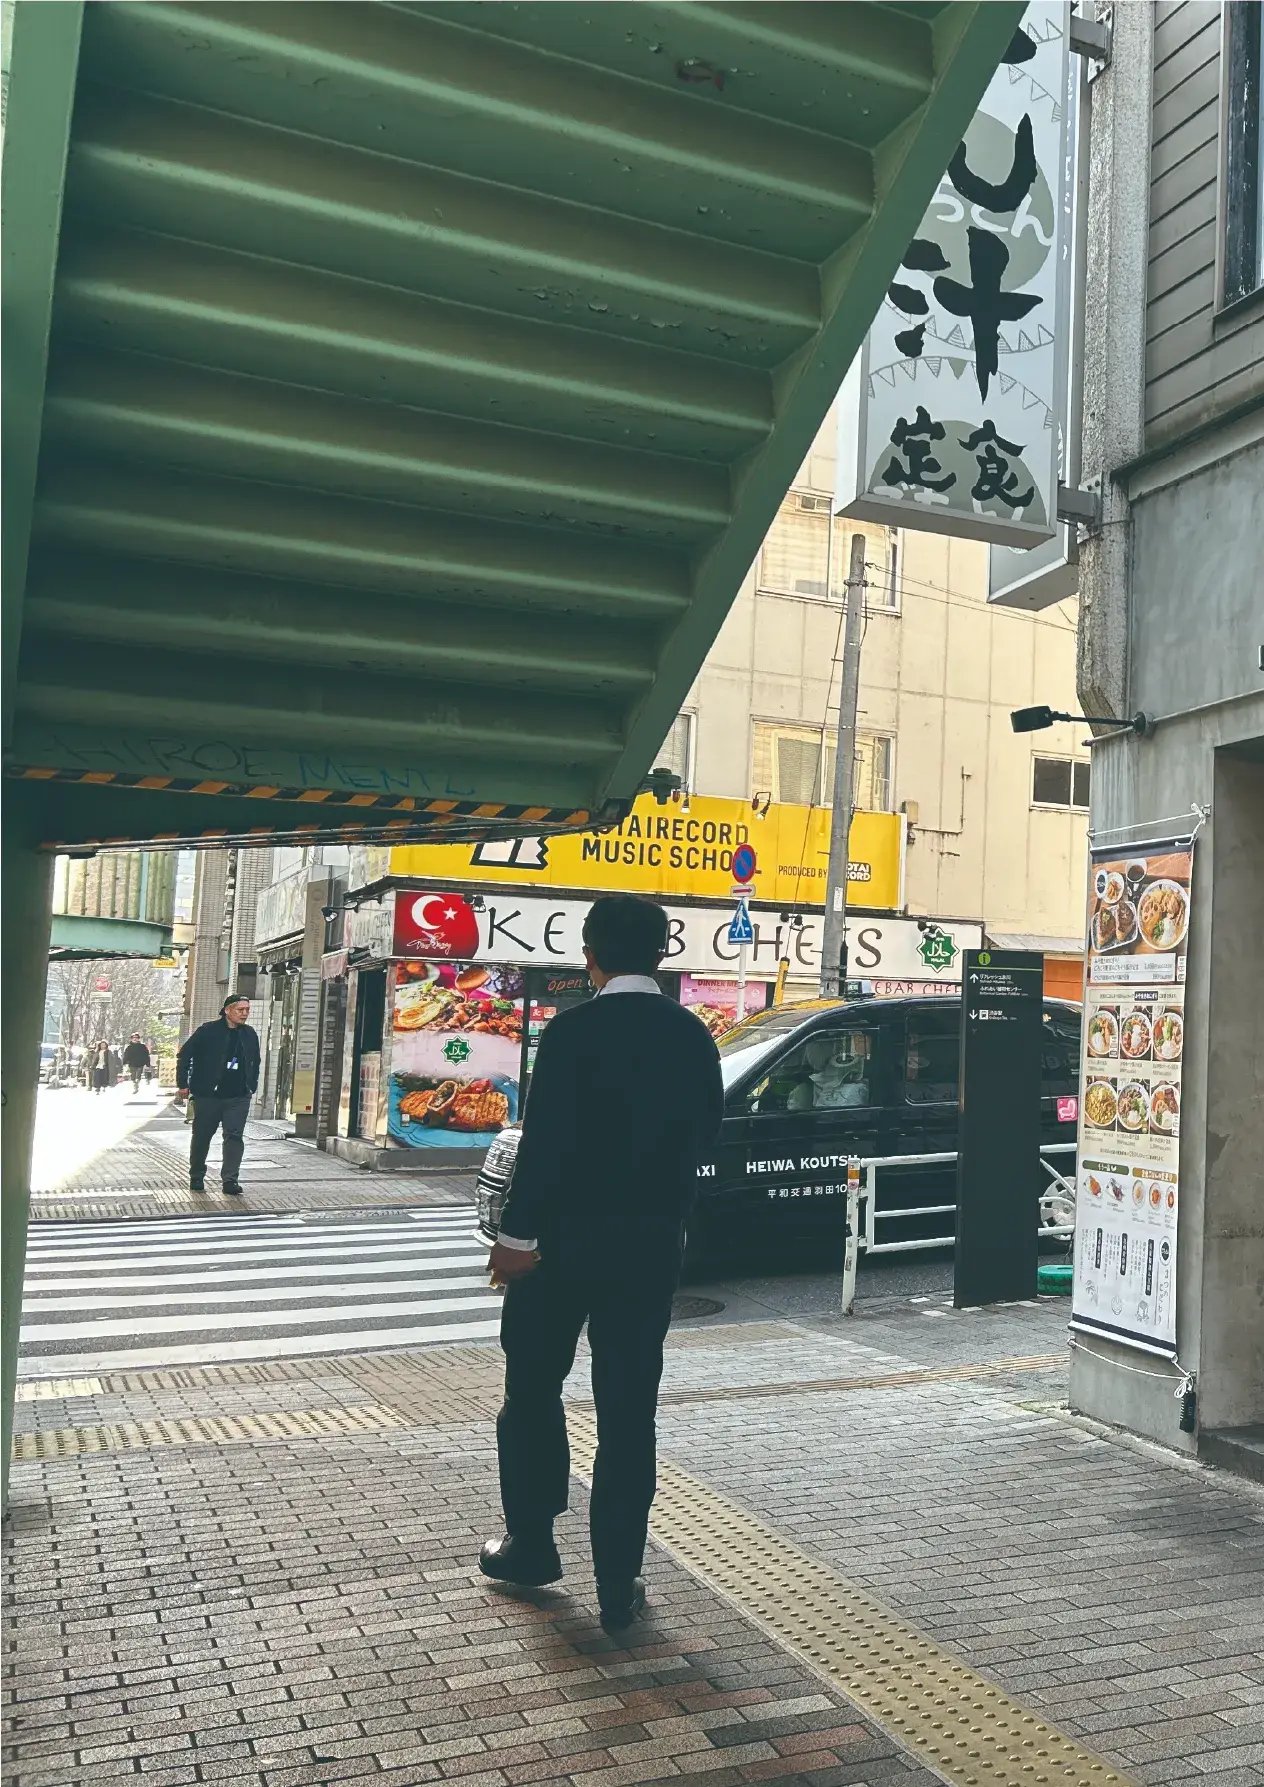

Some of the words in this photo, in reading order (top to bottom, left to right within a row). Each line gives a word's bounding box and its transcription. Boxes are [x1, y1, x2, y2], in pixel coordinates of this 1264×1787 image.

[882, 406, 1035, 508] 定食
[581, 838, 663, 867] MUSIC
[668, 845, 762, 874] SCHO
[847, 862, 870, 872] OTAI
[778, 865, 816, 878] PRODUCED
[818, 868, 828, 879] BY
[487, 906, 687, 959] KEB
[713, 922, 883, 968] CHES
[746, 1158, 796, 1174] HEIWA
